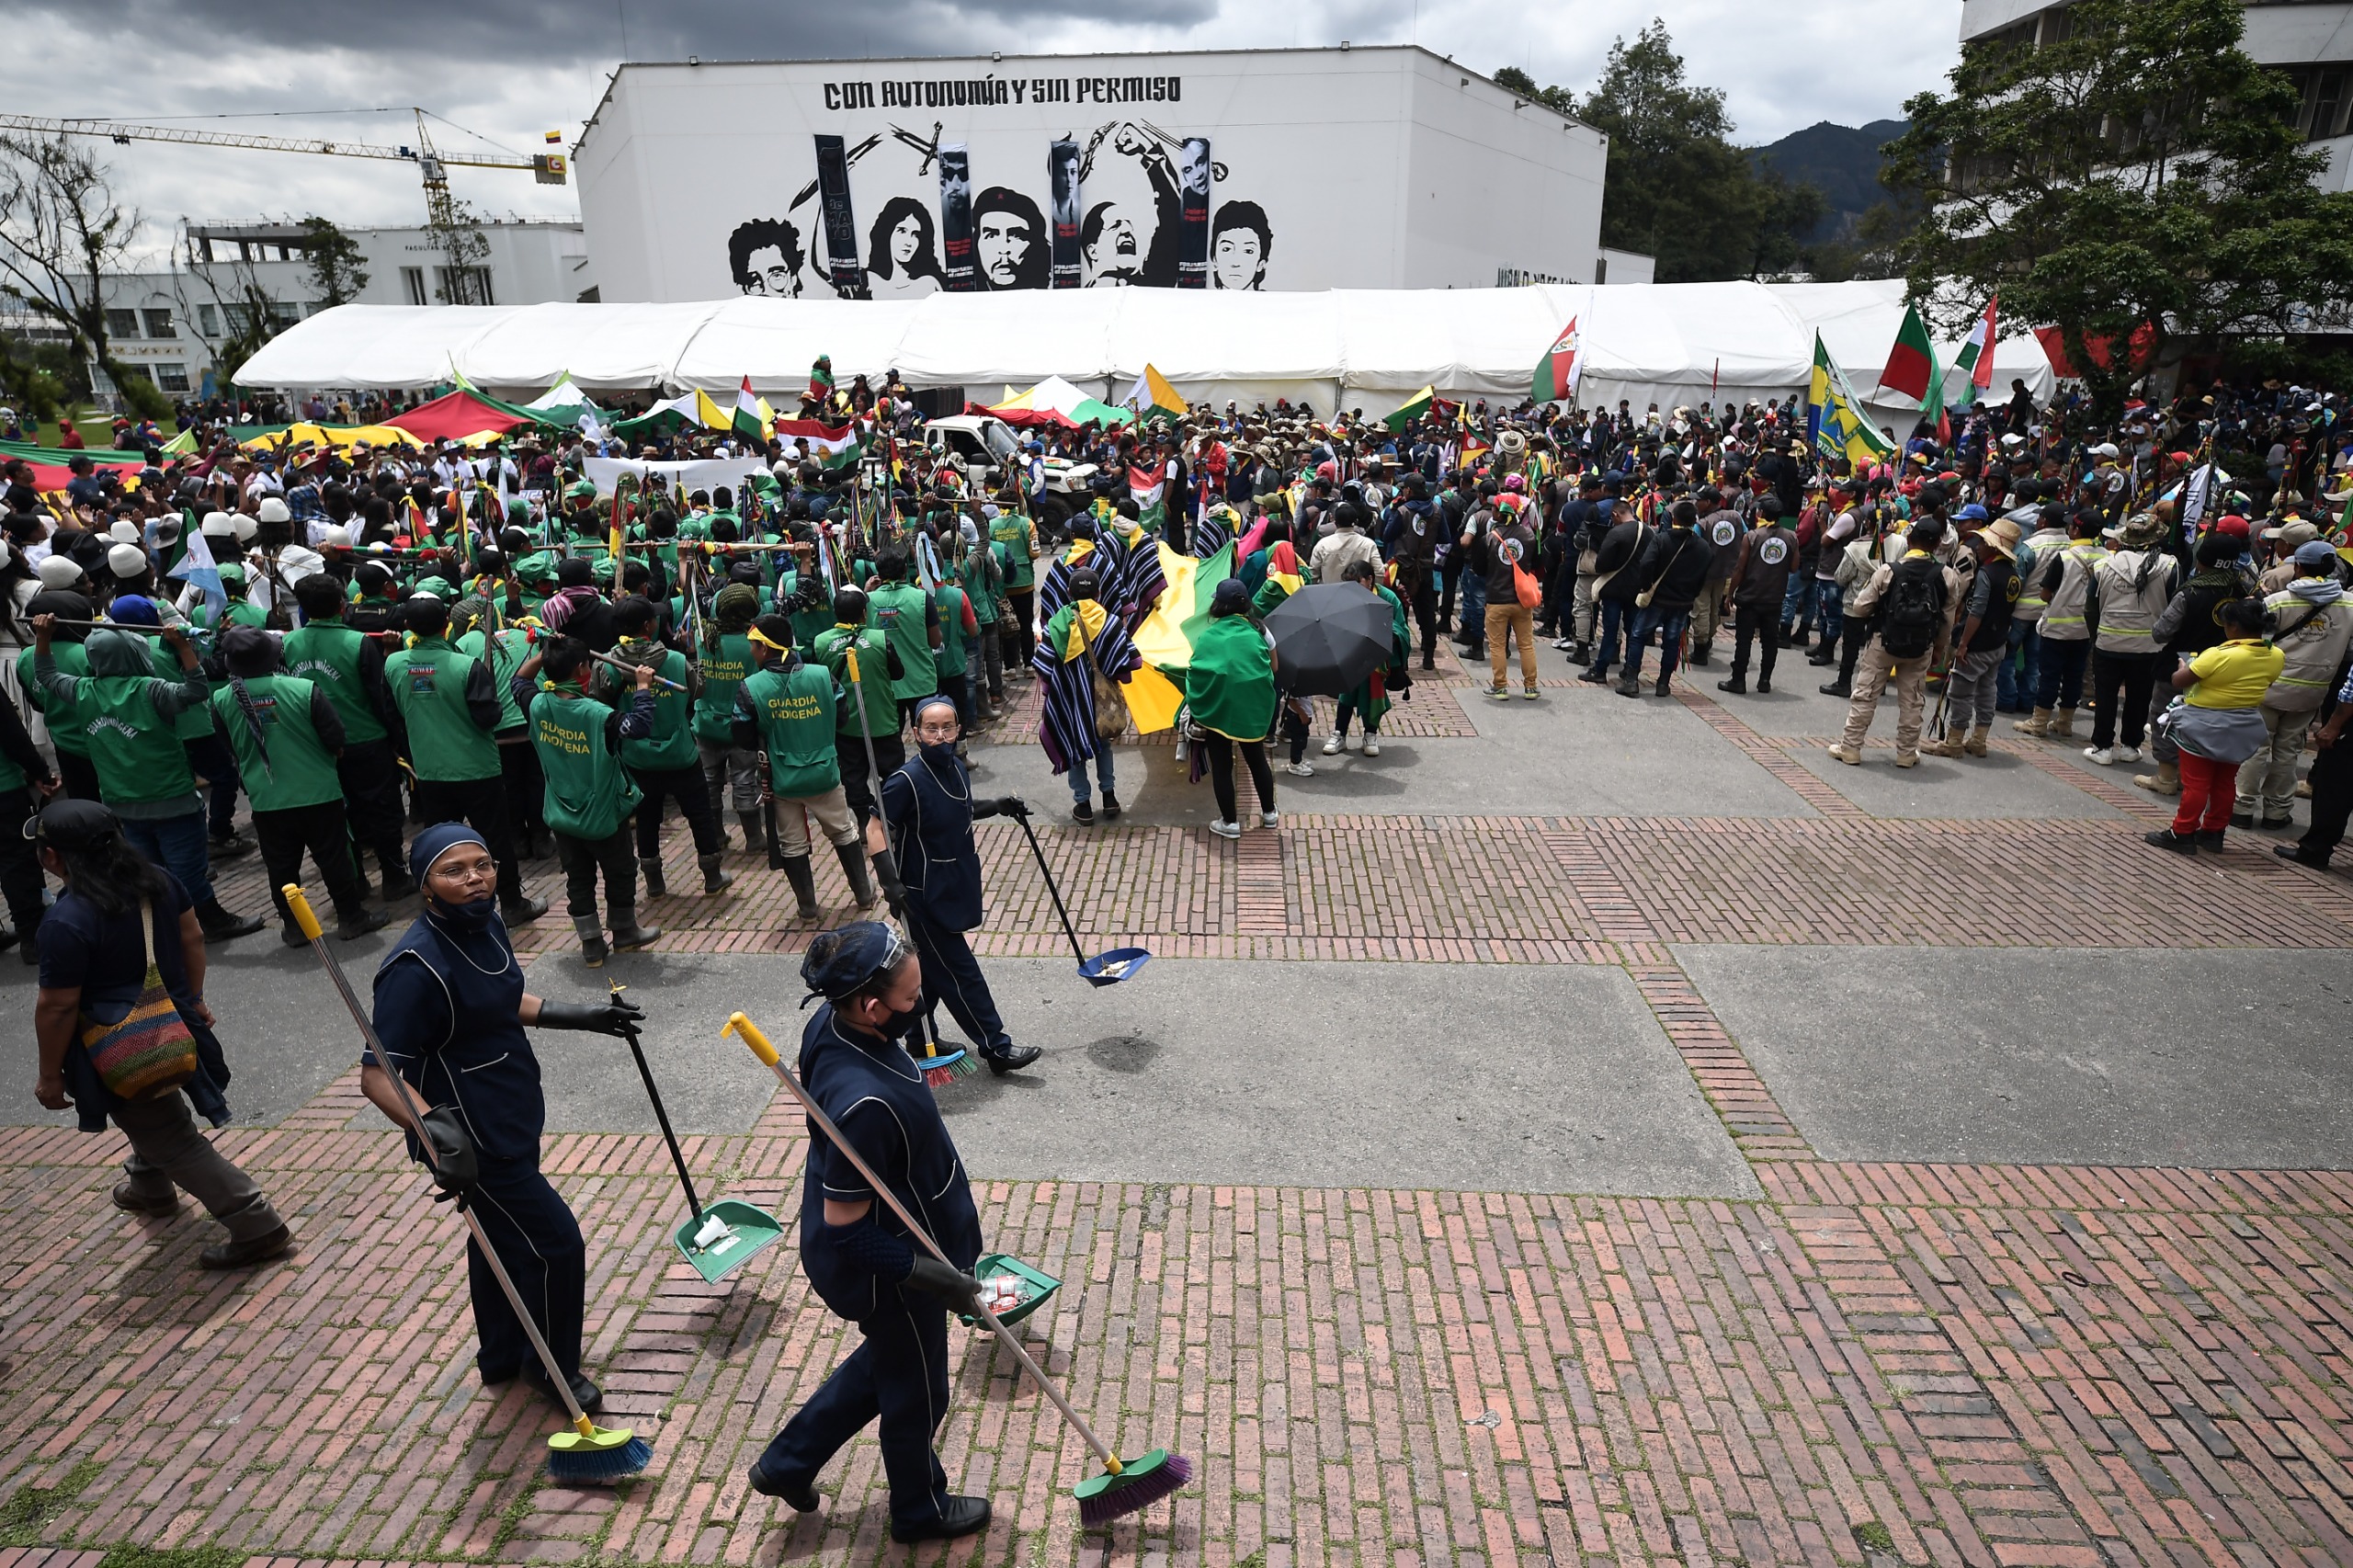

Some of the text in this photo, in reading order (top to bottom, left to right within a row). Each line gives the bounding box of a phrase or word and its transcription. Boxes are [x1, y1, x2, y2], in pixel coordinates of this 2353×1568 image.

[824, 74, 1180, 110] CON AUTONOMÍA Y SIN PERMISO
[703, 669, 745, 680] NDIGENA
[768, 695, 817, 708] GUARDIA
[540, 732, 590, 755] INDIENA
